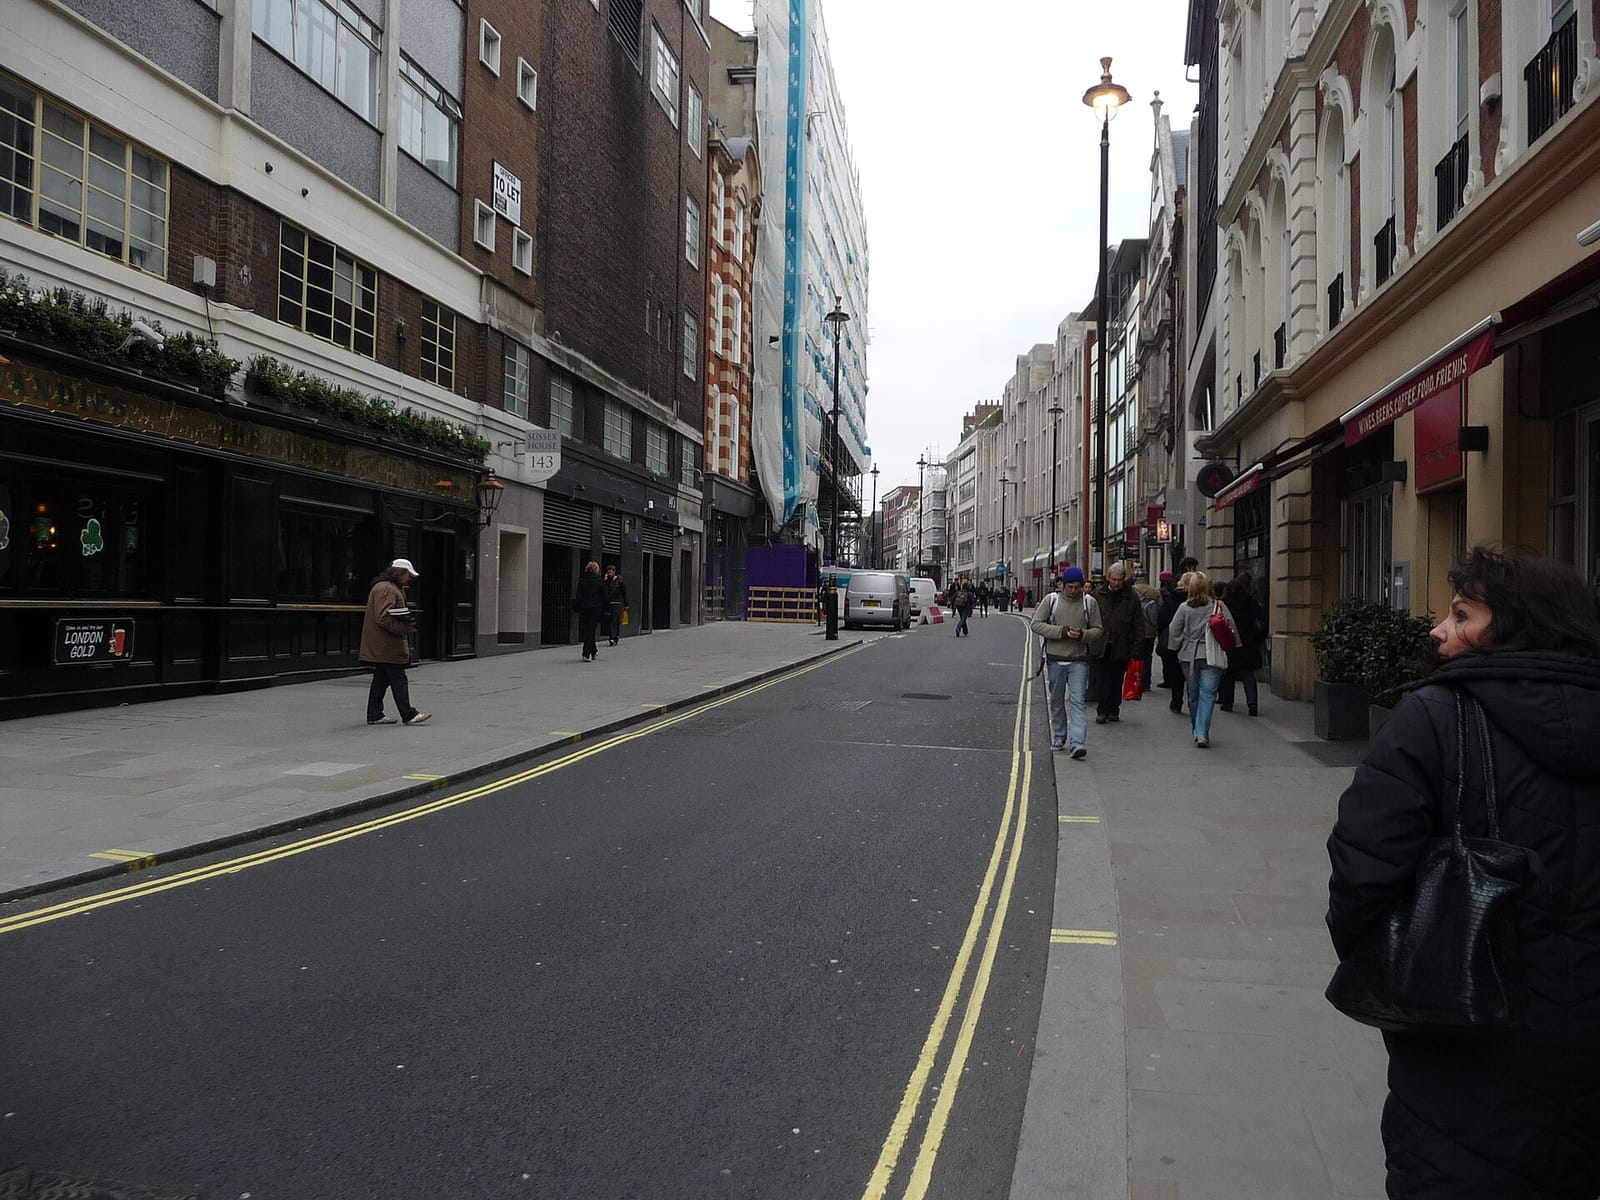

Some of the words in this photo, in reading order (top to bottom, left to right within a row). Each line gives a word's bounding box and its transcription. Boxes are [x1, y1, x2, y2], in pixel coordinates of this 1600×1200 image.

[495, 174, 505, 193] TO
[507, 183, 520, 204] LET
[528, 432, 557, 441] SUSSEX
[528, 441, 556, 450] HOUSE
[531, 455, 554, 468] 143
[64, 631, 104, 645] LONDON
[70, 645, 95, 659] GOLD
